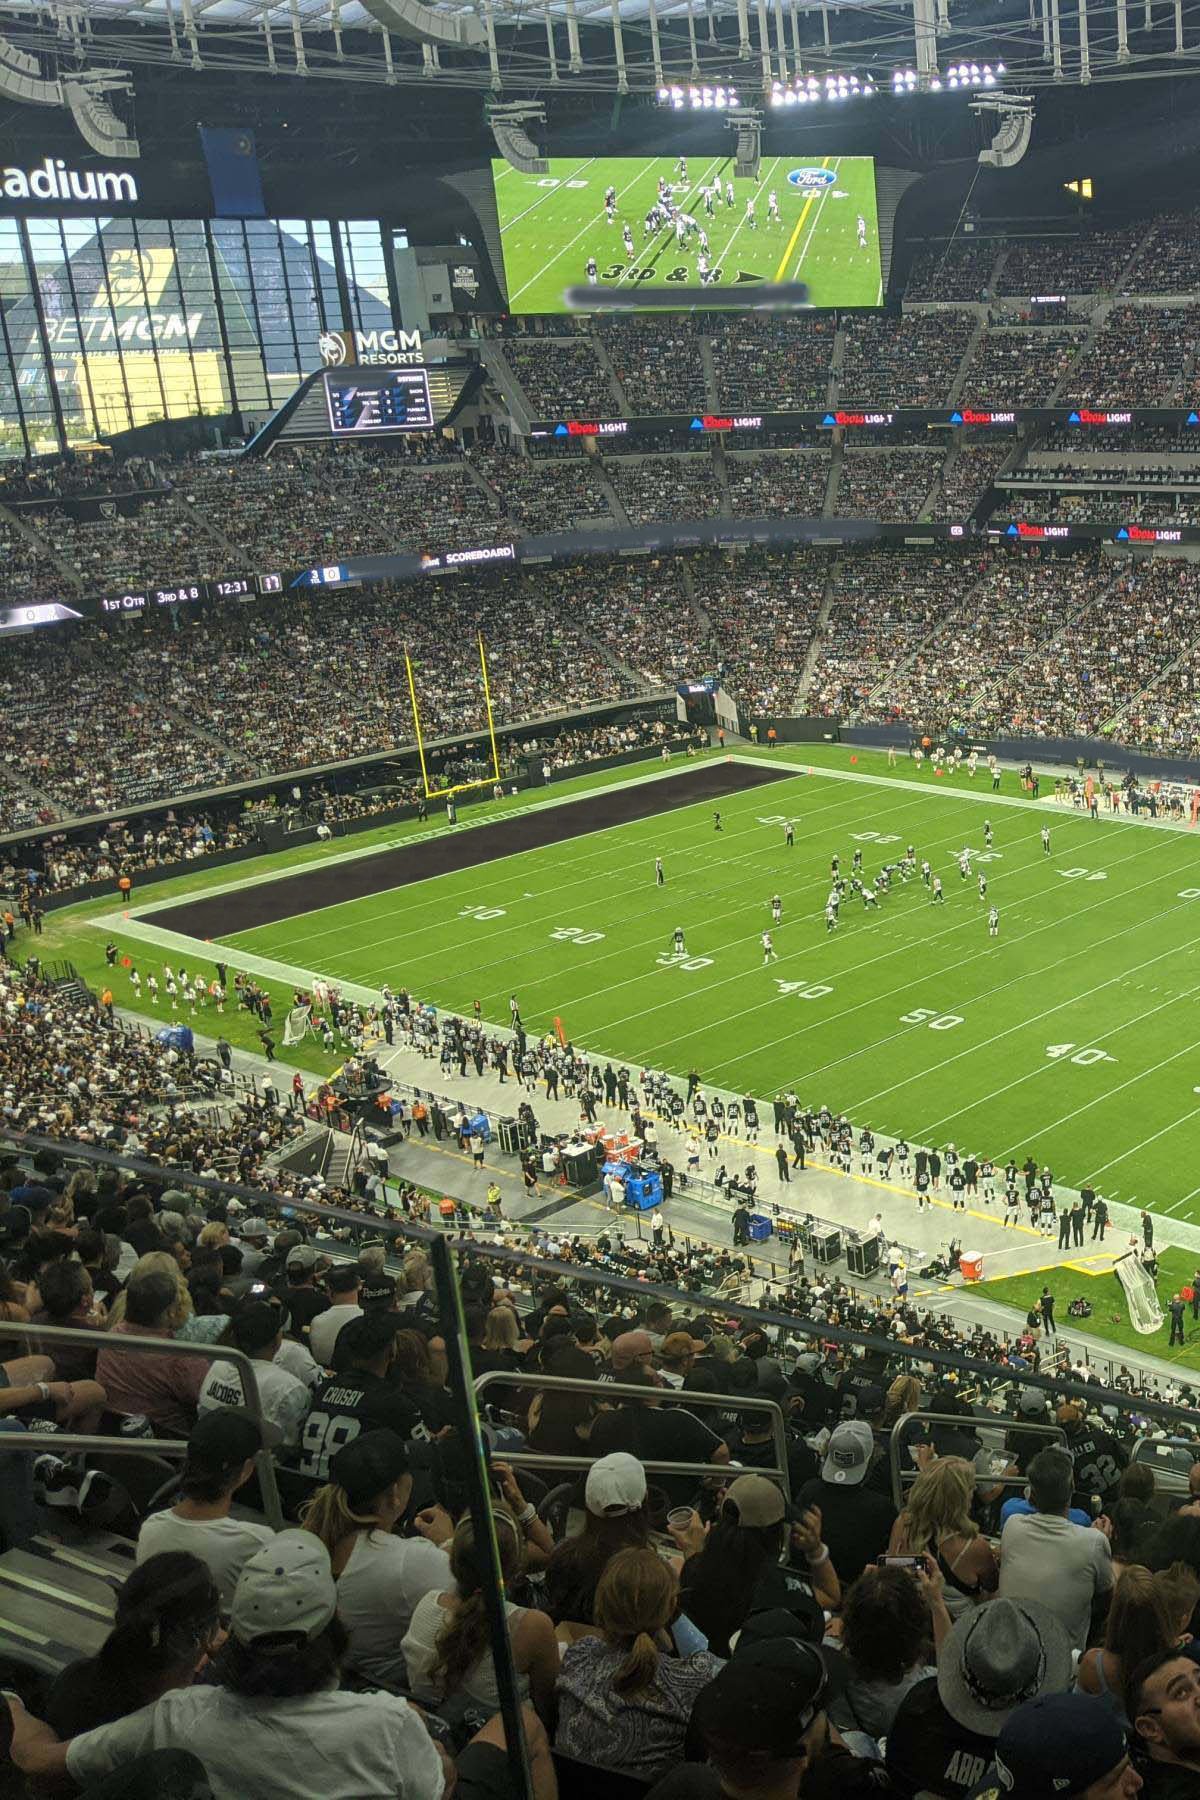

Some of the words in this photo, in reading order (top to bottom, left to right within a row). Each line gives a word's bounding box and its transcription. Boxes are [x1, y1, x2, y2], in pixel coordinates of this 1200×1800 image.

[0, 158, 138, 200] adium
[797, 169, 827, 185] Ford
[665, 268, 690, 283] &
[356, 330, 422, 351] MGM
[360, 352, 424, 366] RESORTS
[732, 416, 762, 428] LIGHT
[989, 411, 1014, 423] LIGHT
[1107, 412, 1132, 424] LIGHT
[599, 422, 628, 434] LIGHT
[1018, 522, 1045, 538] Coors
[1044, 527, 1068, 538] LIGHT
[1128, 526, 1156, 540] Coors
[1156, 529, 1181, 541] LIGHT
[446, 546, 511, 564] SCOREBOARD
[265, 575, 280, 590] 17
[311, 570, 319, 579] 3
[156, 591, 177, 603] 3RD
[179, 589, 188, 600] &
[190, 587, 199, 599] 8
[217, 581, 248, 595] 12:31
[102, 599, 121, 611] 1ST
[123, 595, 145, 608] QTR
[457, 905, 507, 920] 10
[548, 927, 606, 944] 20
[655, 950, 714, 971] 30
[776, 980, 833, 999] 40
[899, 1008, 964, 1030] 50
[1045, 1043, 1107, 1065] 40
[207, 1380, 242, 1405] JACOBS
[322, 1386, 365, 1408] CROSBY
[1080, 1454, 1121, 1494] 32
